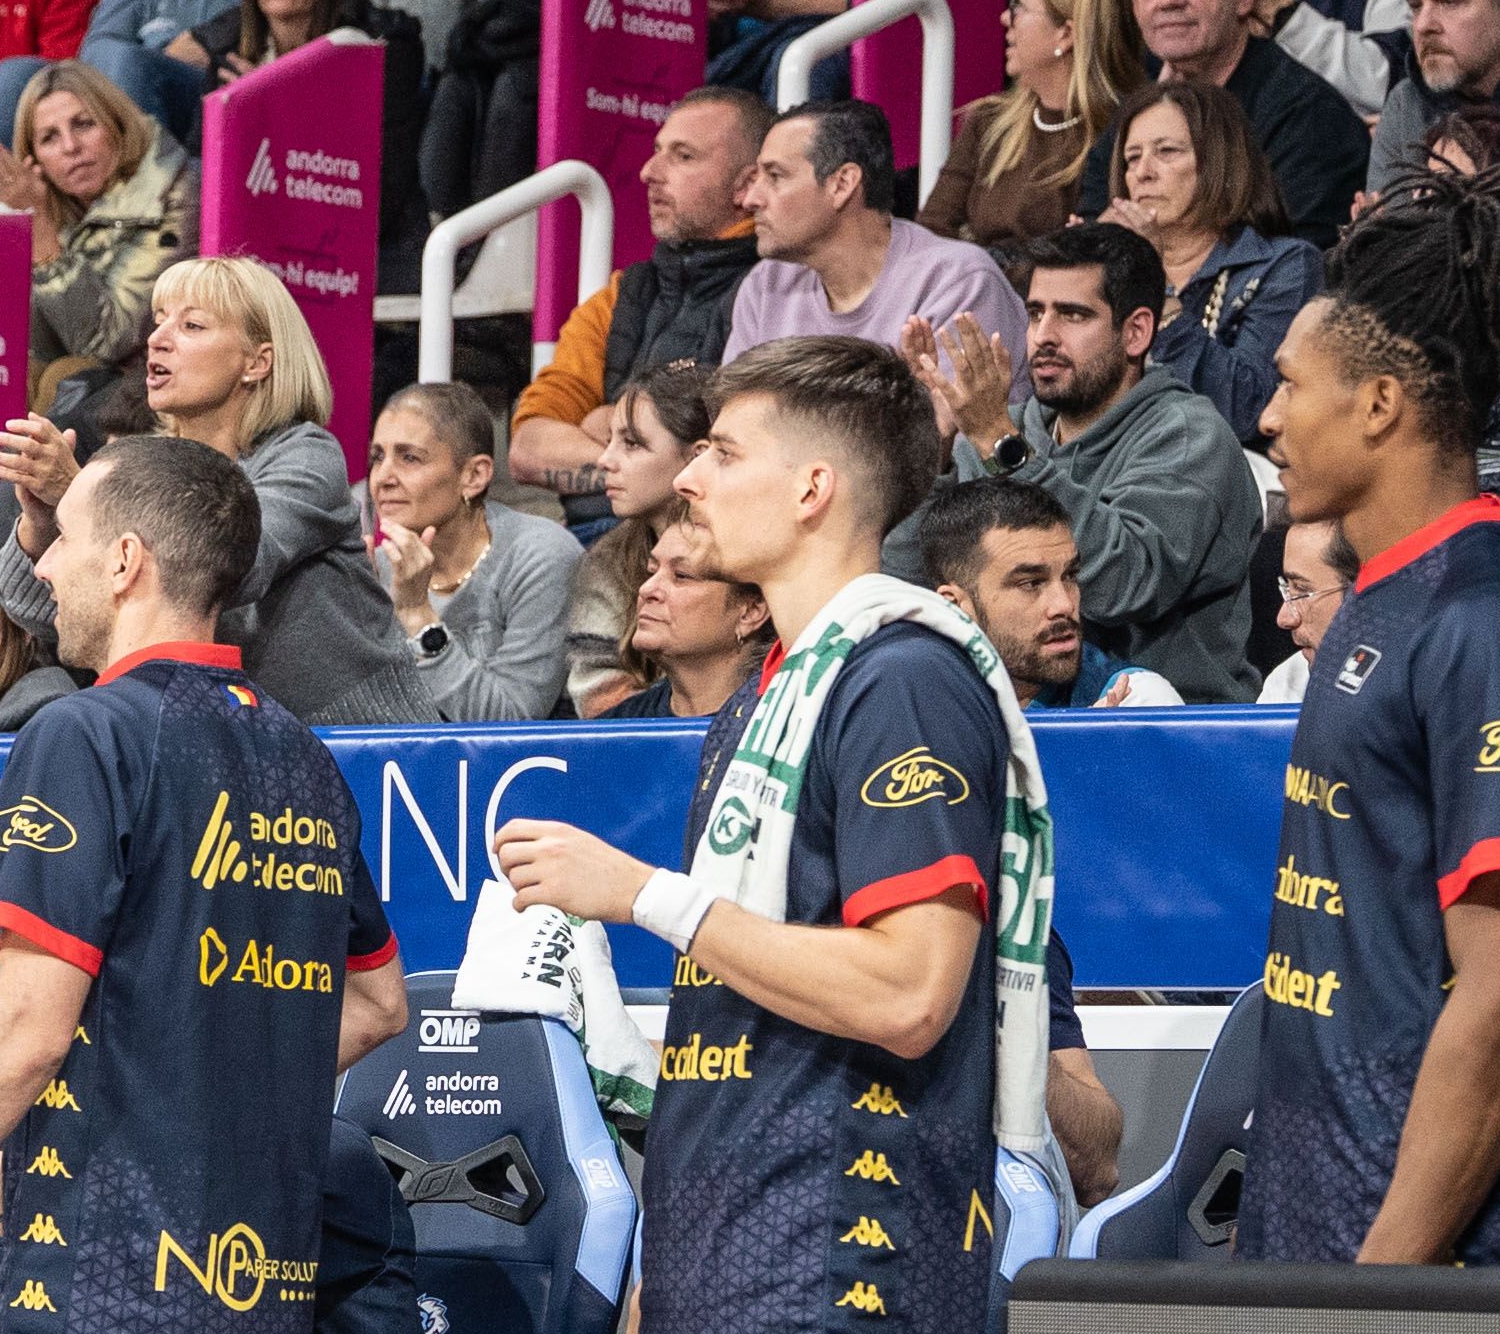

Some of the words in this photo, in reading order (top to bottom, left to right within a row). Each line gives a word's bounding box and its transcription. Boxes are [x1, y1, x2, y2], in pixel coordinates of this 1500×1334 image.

[621, 11, 696, 44] telecom
[286, 149, 361, 181] andorra
[286, 174, 364, 209] telecom
[884, 754, 946, 800] For
[419, 1017, 470, 1046] OMP
[426, 1072, 499, 1092] andorra
[426, 1095, 502, 1115] telecom
